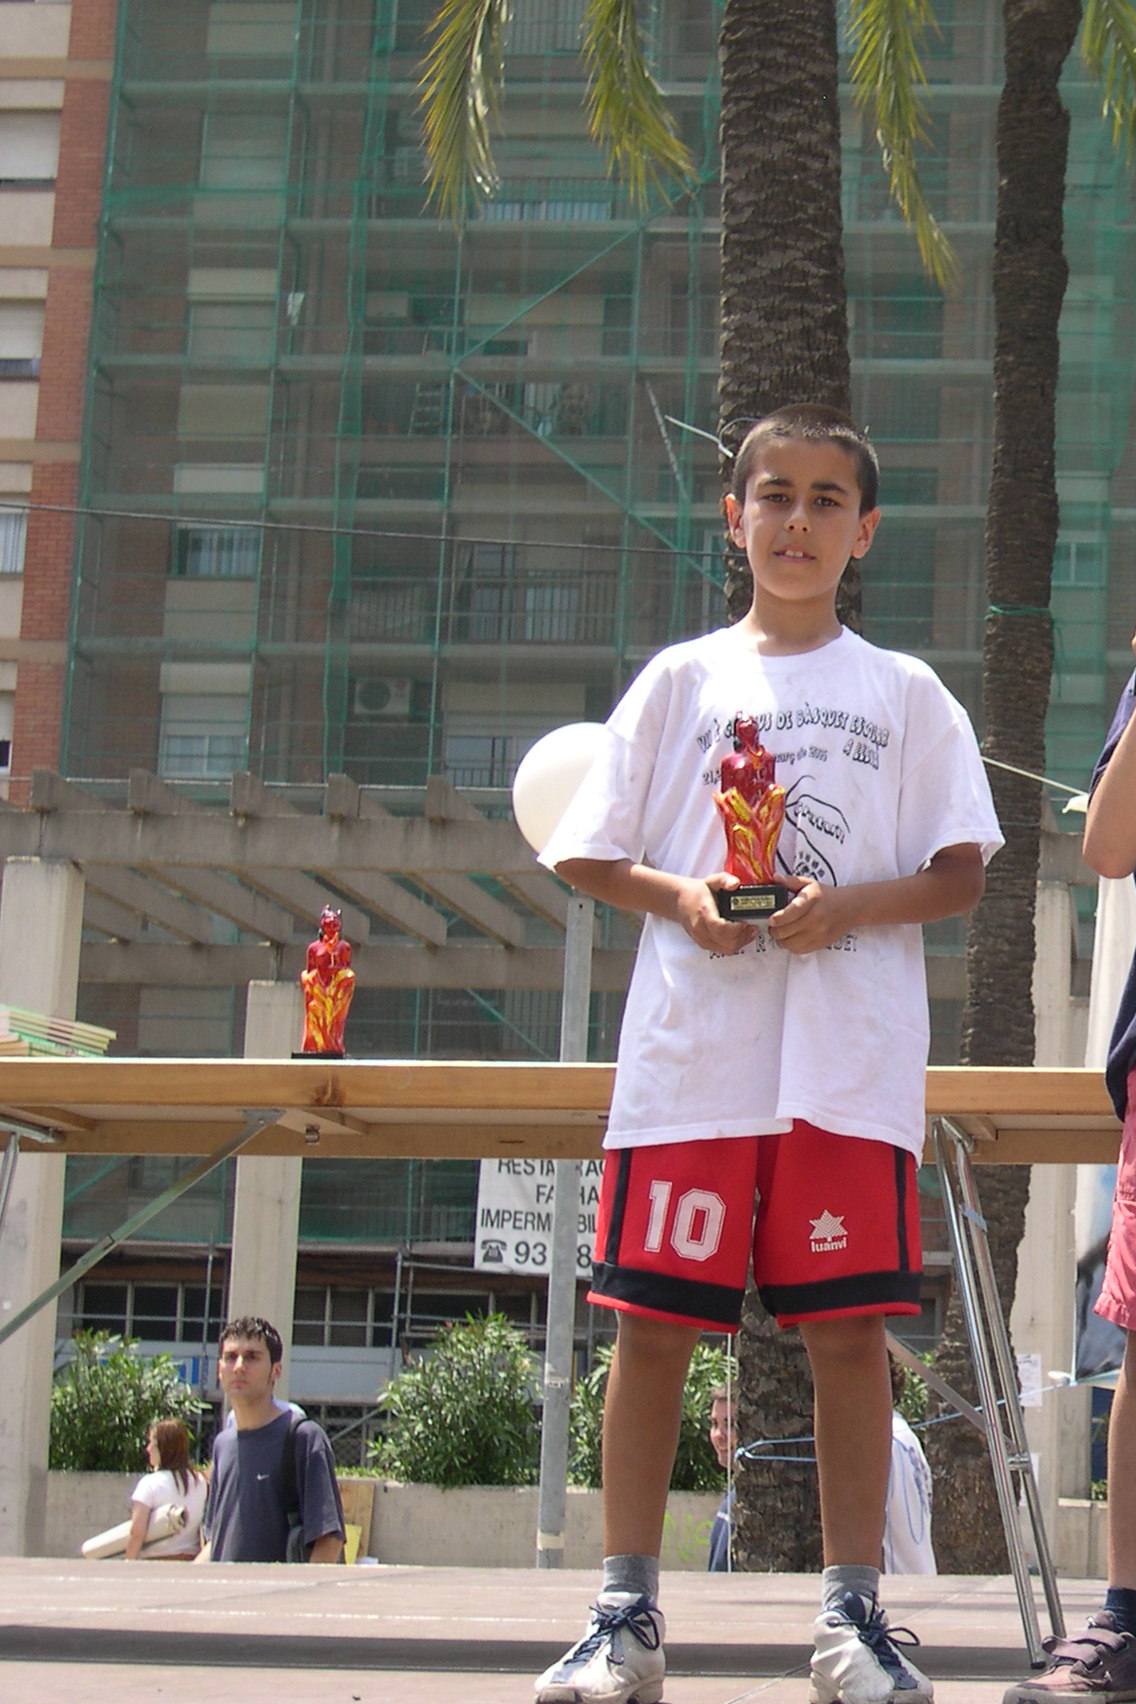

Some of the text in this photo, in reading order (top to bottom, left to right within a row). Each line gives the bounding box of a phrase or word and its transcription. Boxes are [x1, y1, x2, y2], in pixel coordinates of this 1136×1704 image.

[776, 711, 793, 731] DE
[797, 702, 849, 730] BÀSQUET
[644, 1180, 727, 1262] 10
[514, 1241, 547, 1265] 93
